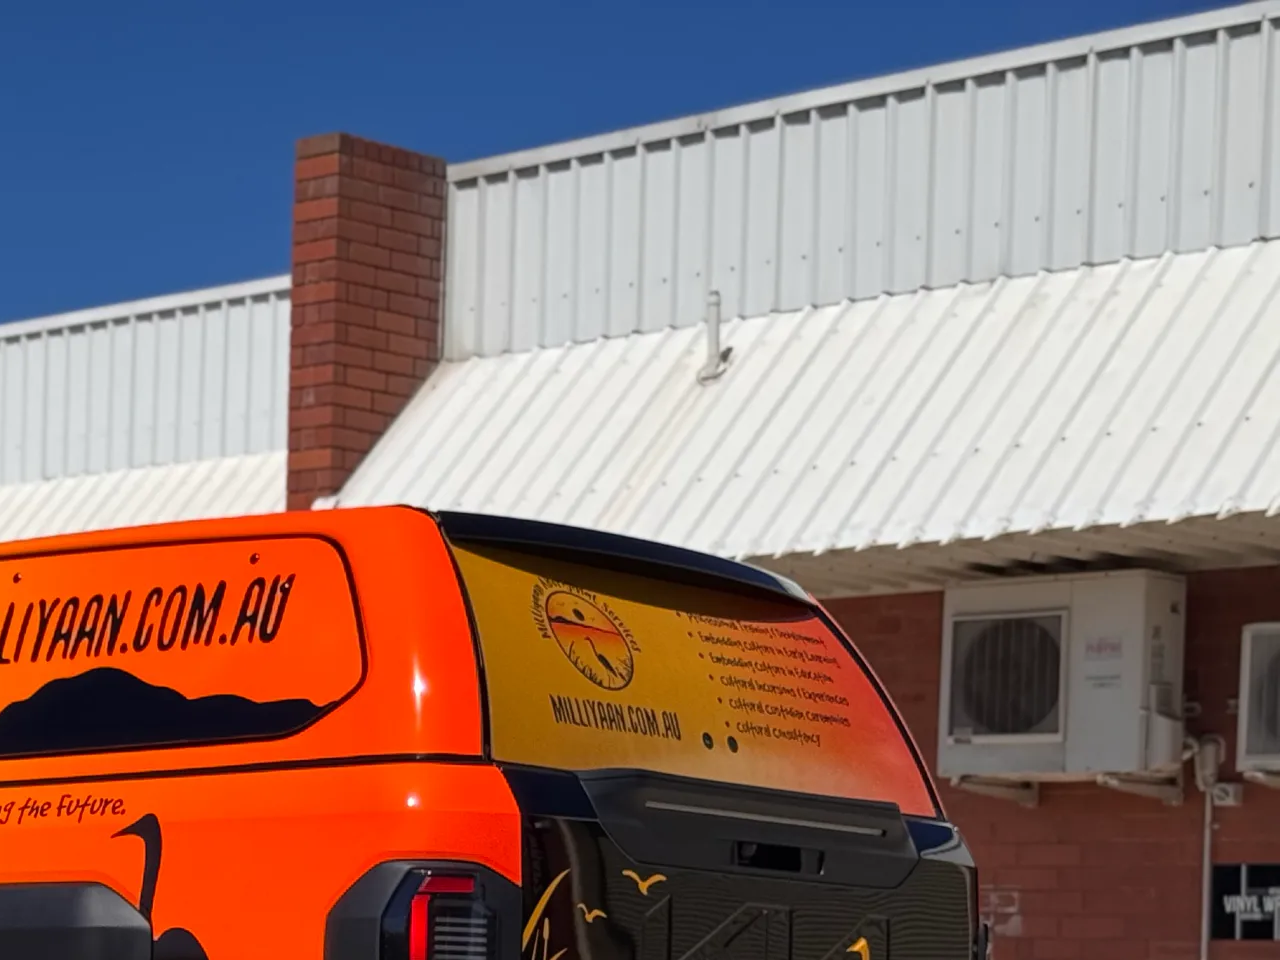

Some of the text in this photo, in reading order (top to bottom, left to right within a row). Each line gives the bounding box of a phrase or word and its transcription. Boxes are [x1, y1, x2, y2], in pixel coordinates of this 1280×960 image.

[601, 602, 642, 653] Services
[549, 693, 682, 741] MILLIYAAN.COM.AU
[17, 797, 52, 825] the
[56, 793, 126, 824] Future.
[1223, 895, 1262, 914] VINYL
